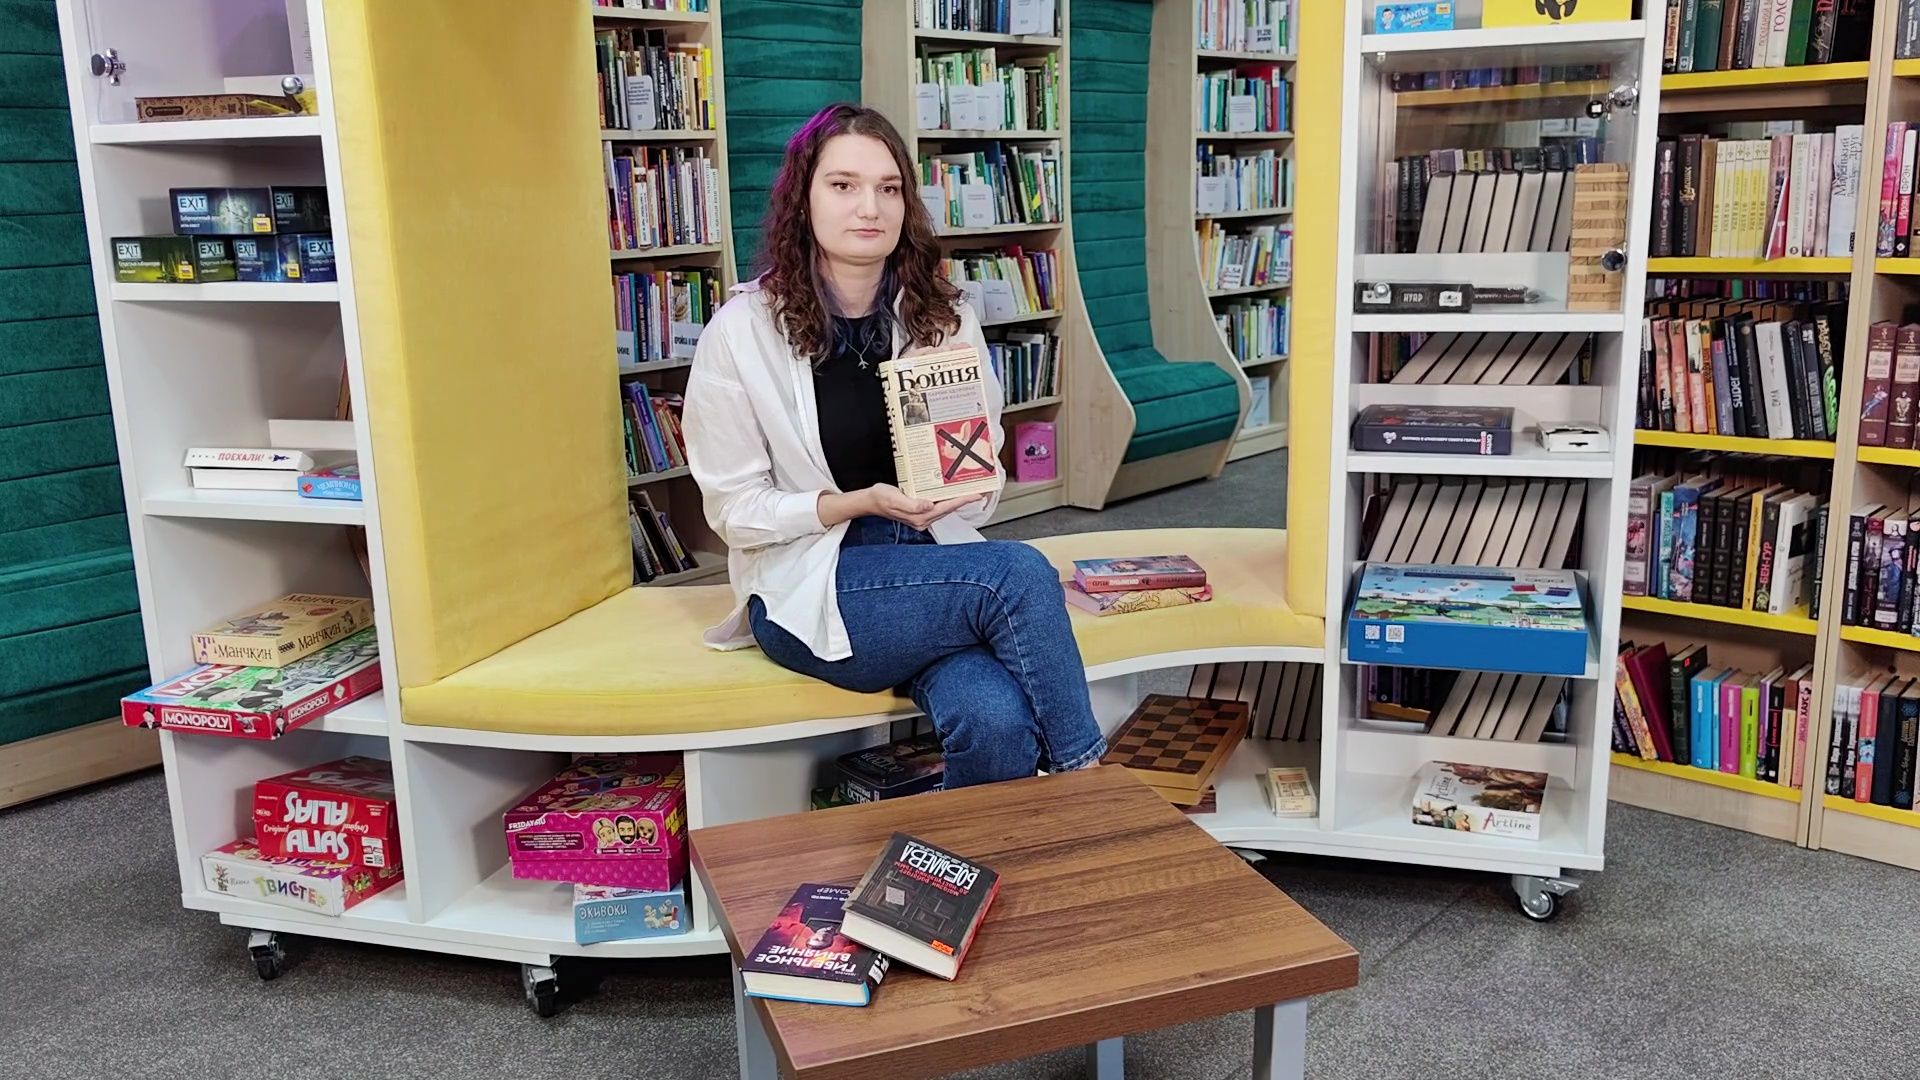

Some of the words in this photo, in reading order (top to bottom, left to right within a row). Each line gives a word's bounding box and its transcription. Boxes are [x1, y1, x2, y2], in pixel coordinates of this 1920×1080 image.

[1400, 8, 1429, 23] ФАНТЫ
[1833, 137, 1850, 196] Маленький
[180, 198, 206, 211] EXIT
[276, 195, 293, 207] EXIT
[118, 245, 139, 257] EXIT
[200, 243, 223, 256] EXIT
[238, 243, 256, 256] EXIT
[309, 241, 334, 254] EXIT
[895, 364, 980, 393] Бойня
[1731, 376, 1743, 408] super
[218, 452, 265, 462] ПОЕХАЛИ!
[1759, 541, 1773, 584] БЕН-ГУР
[298, 622, 342, 651] Манчкин
[218, 644, 273, 662] Манчкин
[290, 694, 330, 720] MONOPOLY
[1798, 697, 1810, 716] ХАУС
[164, 711, 229, 729] MONOPOLY
[283, 791, 348, 826] ALIAS
[263, 824, 290, 835] Original
[342, 823, 369, 834] Original
[1482, 811, 1532, 831] Artline
[286, 829, 349, 860] ALIAS
[816, 887, 850, 895] ОМЕР
[579, 904, 629, 920] ЭКИВОКИ
[768, 945, 852, 963] ВЛИЯНИЕ
[754, 953, 858, 974] ГИБЕЛЬНОЕ
